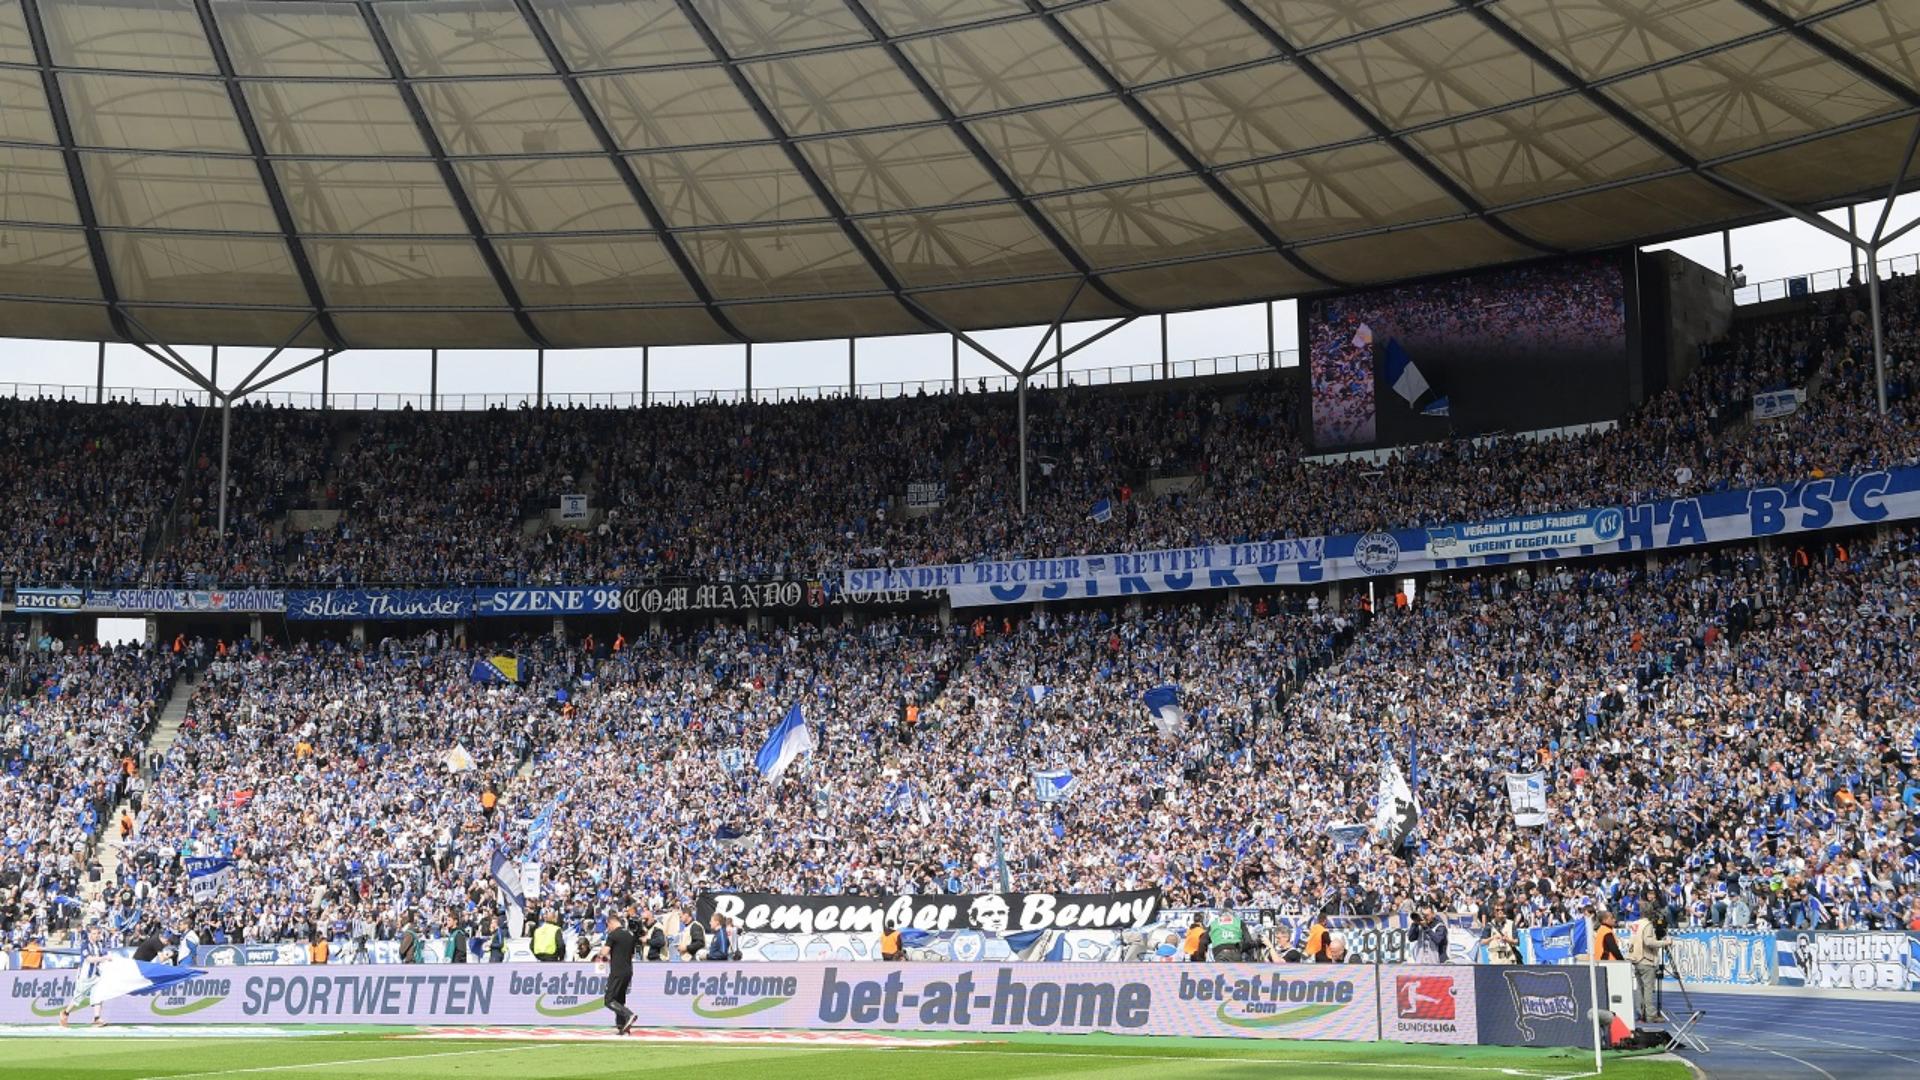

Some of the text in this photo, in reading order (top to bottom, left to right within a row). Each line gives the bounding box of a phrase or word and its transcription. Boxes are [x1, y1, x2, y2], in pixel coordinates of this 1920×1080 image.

[1747, 471, 1892, 536] BSC
[1463, 522, 1507, 537] VEREINT
[1509, 520, 1519, 532] IN
[1522, 518, 1544, 532] DEN
[1600, 514, 1618, 534] KSC
[1469, 538, 1512, 554] VEREINT
[1515, 536, 1549, 549] GEGEN
[1551, 533, 1577, 545] ALLE
[850, 564, 965, 591] SPENDET
[974, 558, 1081, 584] BECHER
[1114, 545, 1216, 575] RETTET
[17, 594, 57, 607] KMG
[119, 590, 176, 610] SEKTION
[303, 592, 465, 616] Blue Thunder
[623, 582, 802, 613] COMMANDO
[1020, 892, 1156, 930] Benny
[1816, 933, 1905, 961] MIGHTY
[12, 976, 76, 998] bet-at-h
[509, 971, 631, 996] bet-at-ho
[664, 970, 797, 997] bet-at-home
[1818, 961, 1904, 989] MOB
[243, 975, 494, 1016] SPORTWETTEN
[819, 967, 1152, 1028] bet-at-home
[1179, 972, 1354, 1003] bet-at-home
[552, 996, 578, 1006] .com
[711, 996, 738, 1007] .com
[1241, 1001, 1277, 1014] .com
[1397, 1022, 1457, 1033] BUNDESLIGA
